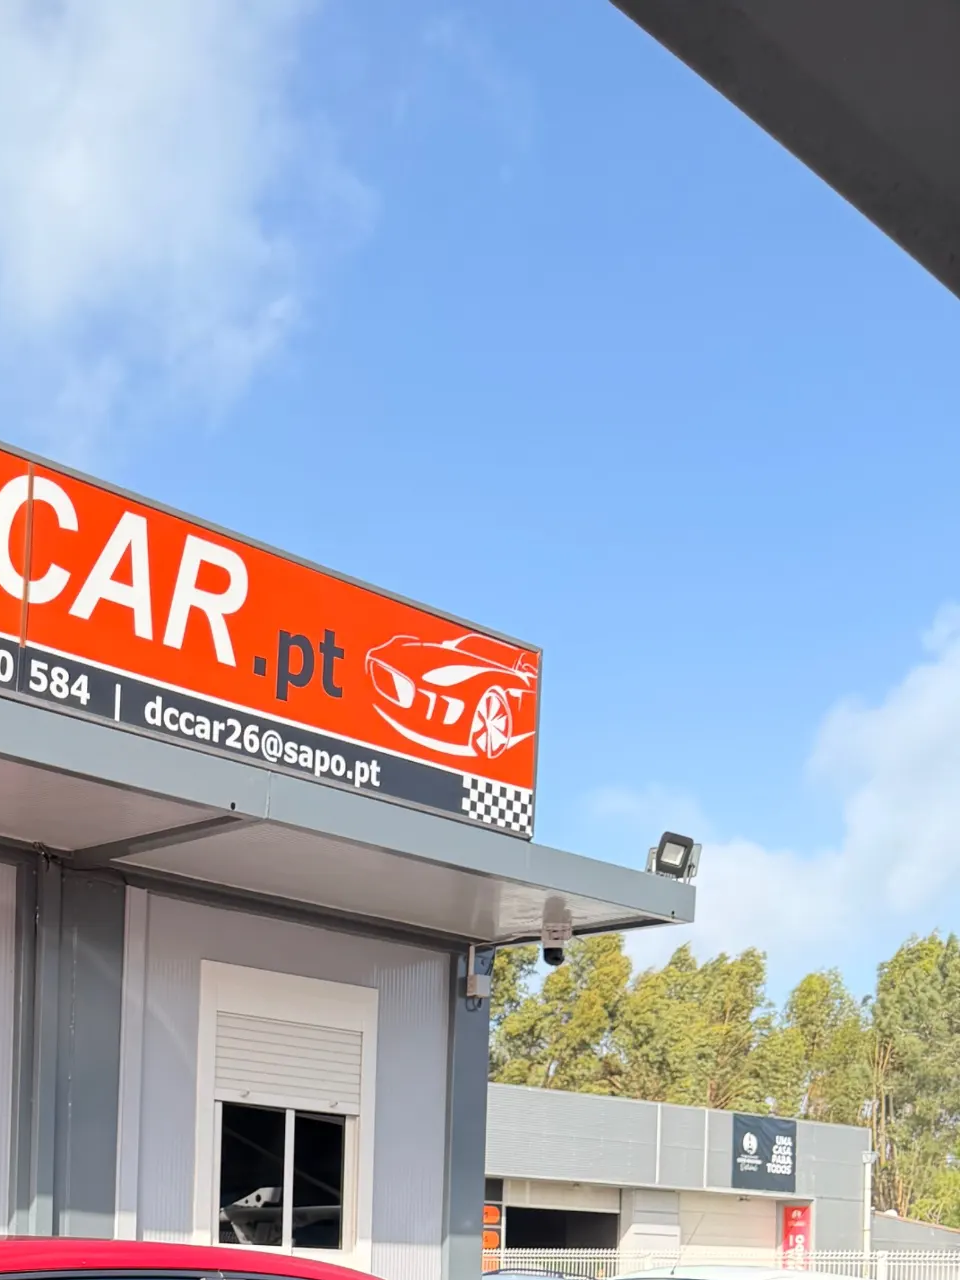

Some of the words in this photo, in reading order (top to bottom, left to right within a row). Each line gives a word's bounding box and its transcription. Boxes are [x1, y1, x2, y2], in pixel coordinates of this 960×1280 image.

[28, 659, 91, 706] 584
[143, 694, 381, 789] dccar26@sapo.pt
[775, 1135, 792, 1146] UMA
[772, 1145, 792, 1156] CASA
[771, 1154, 792, 1165] PARA
[766, 1163, 792, 1175] TODOS
